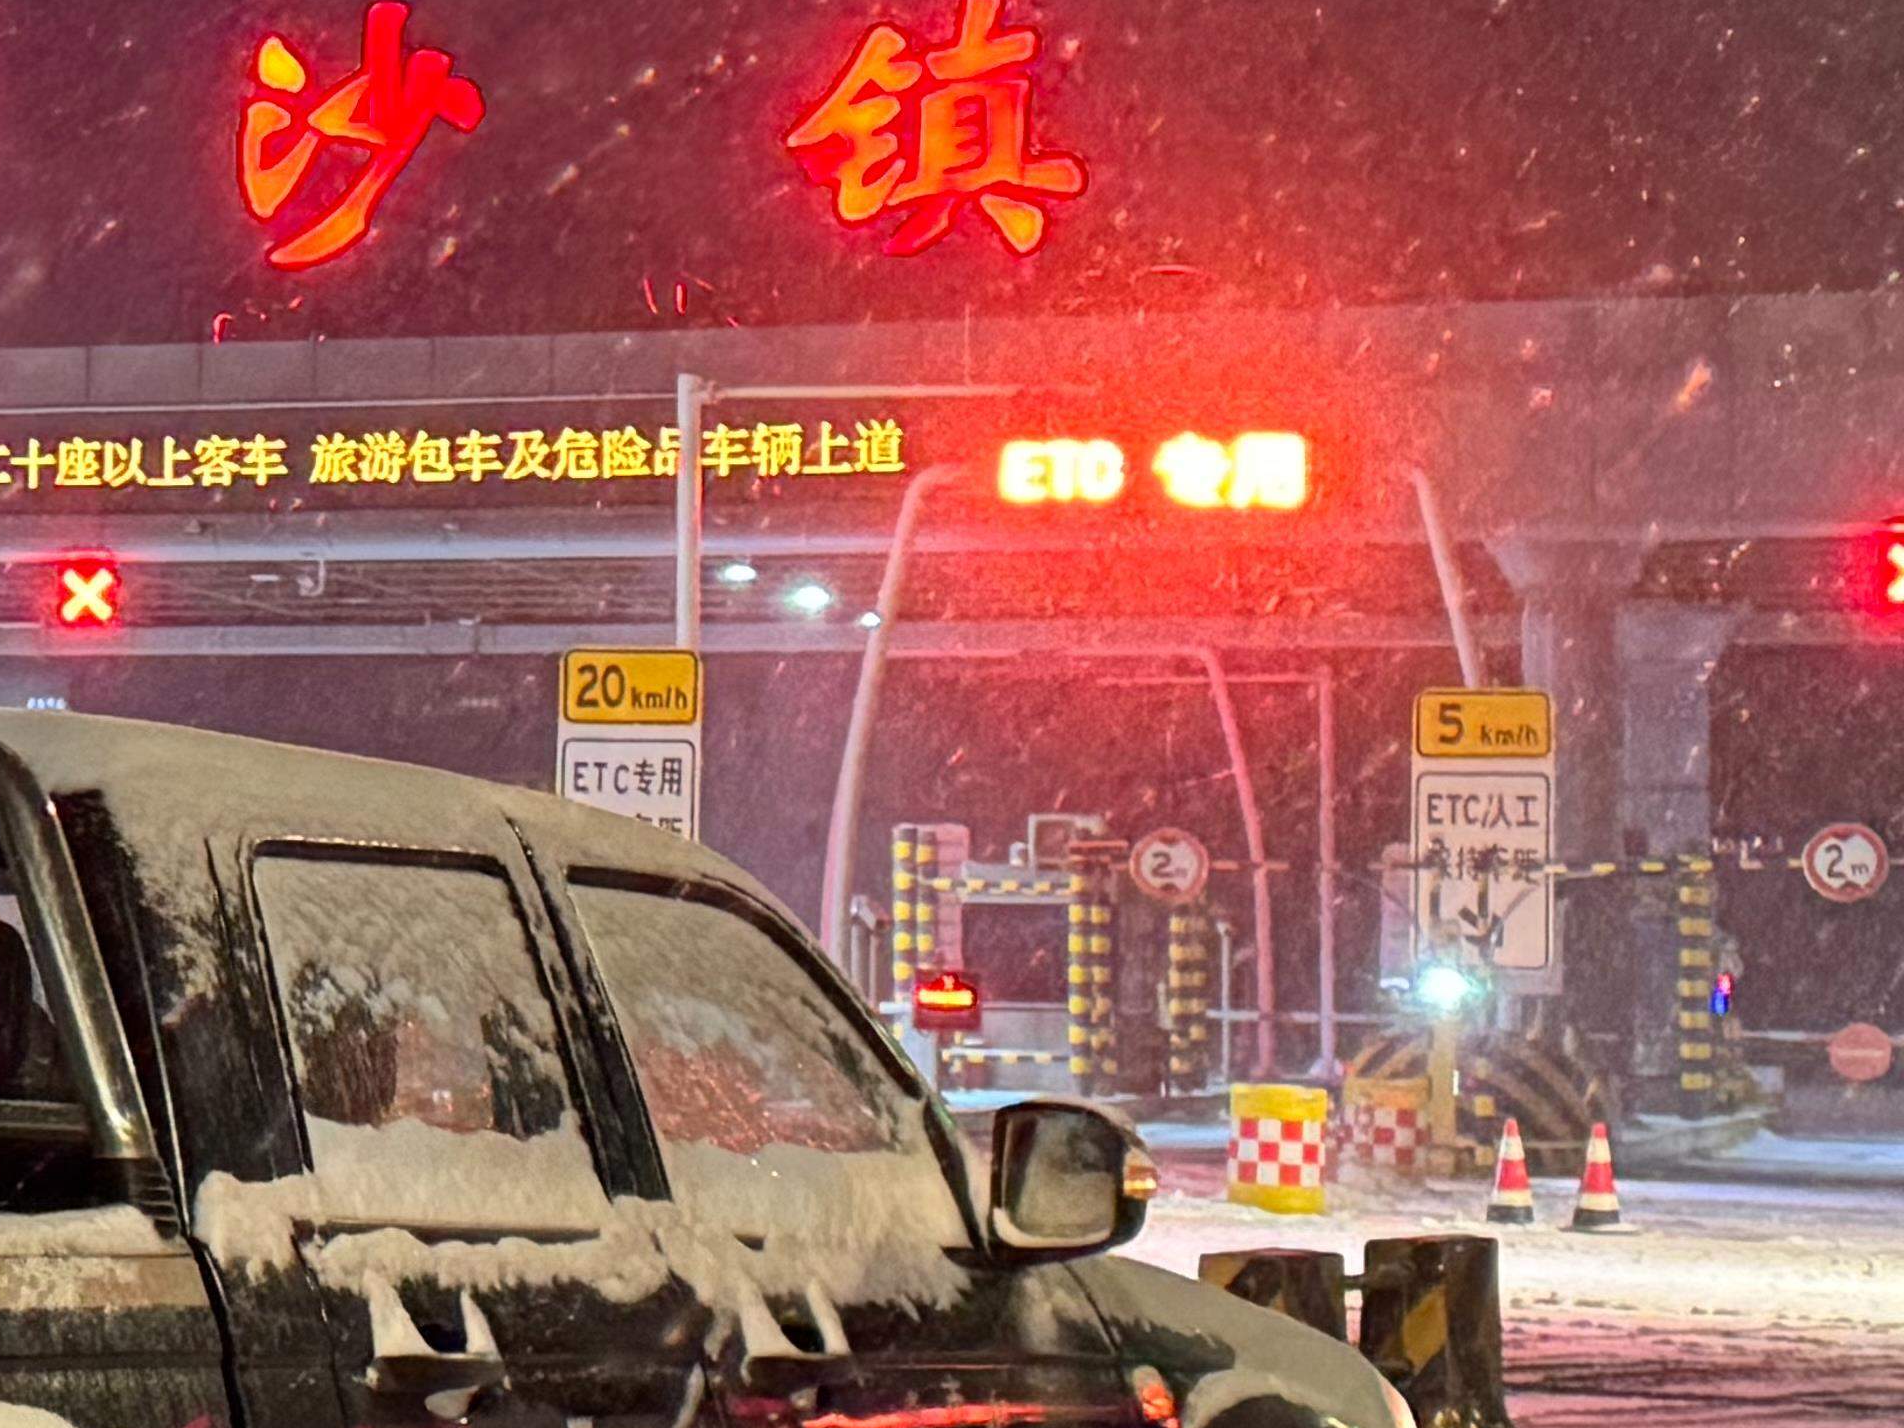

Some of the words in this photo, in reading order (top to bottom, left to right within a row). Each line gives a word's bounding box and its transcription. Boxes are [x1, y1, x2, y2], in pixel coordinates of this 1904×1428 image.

[309, 418, 906, 485] 旅游包车及危险品车辆上道
[573, 757, 683, 796] ETC专用
[1426, 791, 1540, 827] ETC/人工
